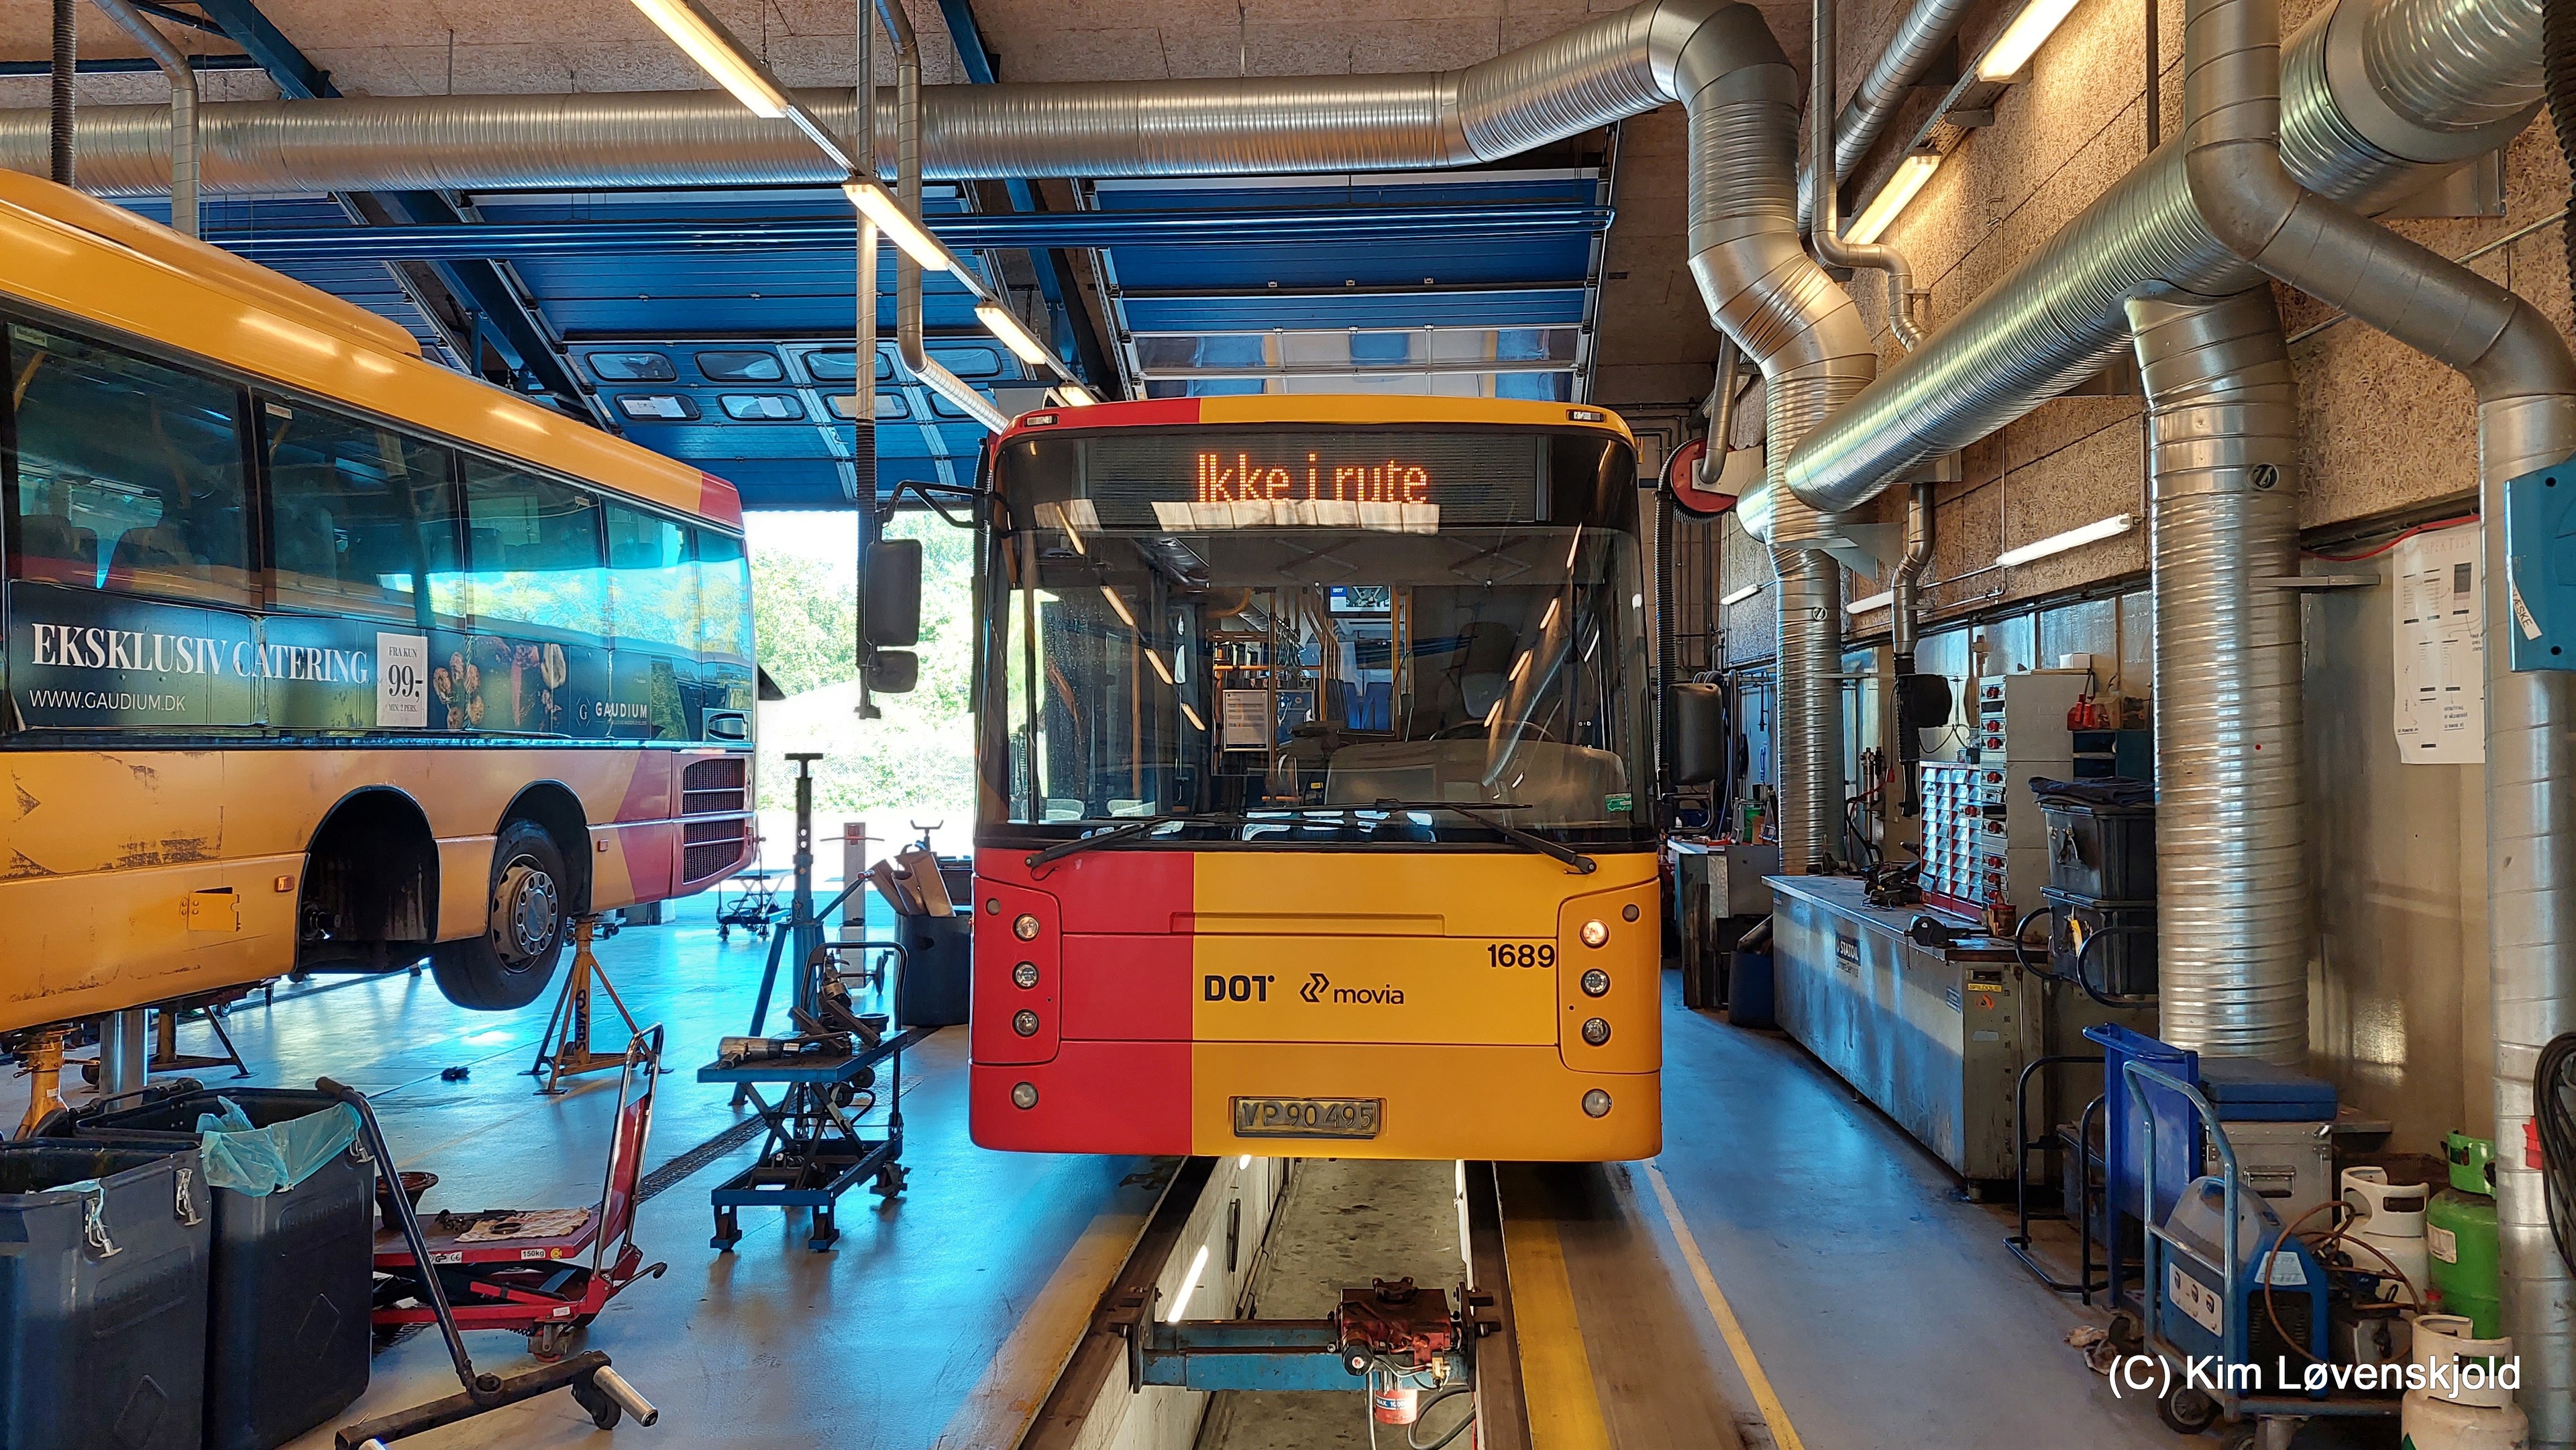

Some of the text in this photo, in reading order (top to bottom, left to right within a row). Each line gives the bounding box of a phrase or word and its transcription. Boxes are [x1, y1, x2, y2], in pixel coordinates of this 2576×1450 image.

[1199, 453, 1427, 506] Ikke i rute
[32, 623, 368, 684] EKSKLUSIV CATERING
[388, 646, 417, 658] FRA KUN
[29, 689, 186, 712] WWW.GAUDIUM.DK
[595, 702, 647, 719] GAUDIUM
[1487, 944, 1555, 968] 1689
[1840, 940, 1859, 961] STATOIL
[1205, 974, 1275, 1002] DOT
[1333, 985, 1405, 1005] movia
[1242, 1102, 1373, 1129] VP 90 495
[523, 1250, 545, 1258] 150kg
[1376, 1398, 1388, 1406] MAX.
